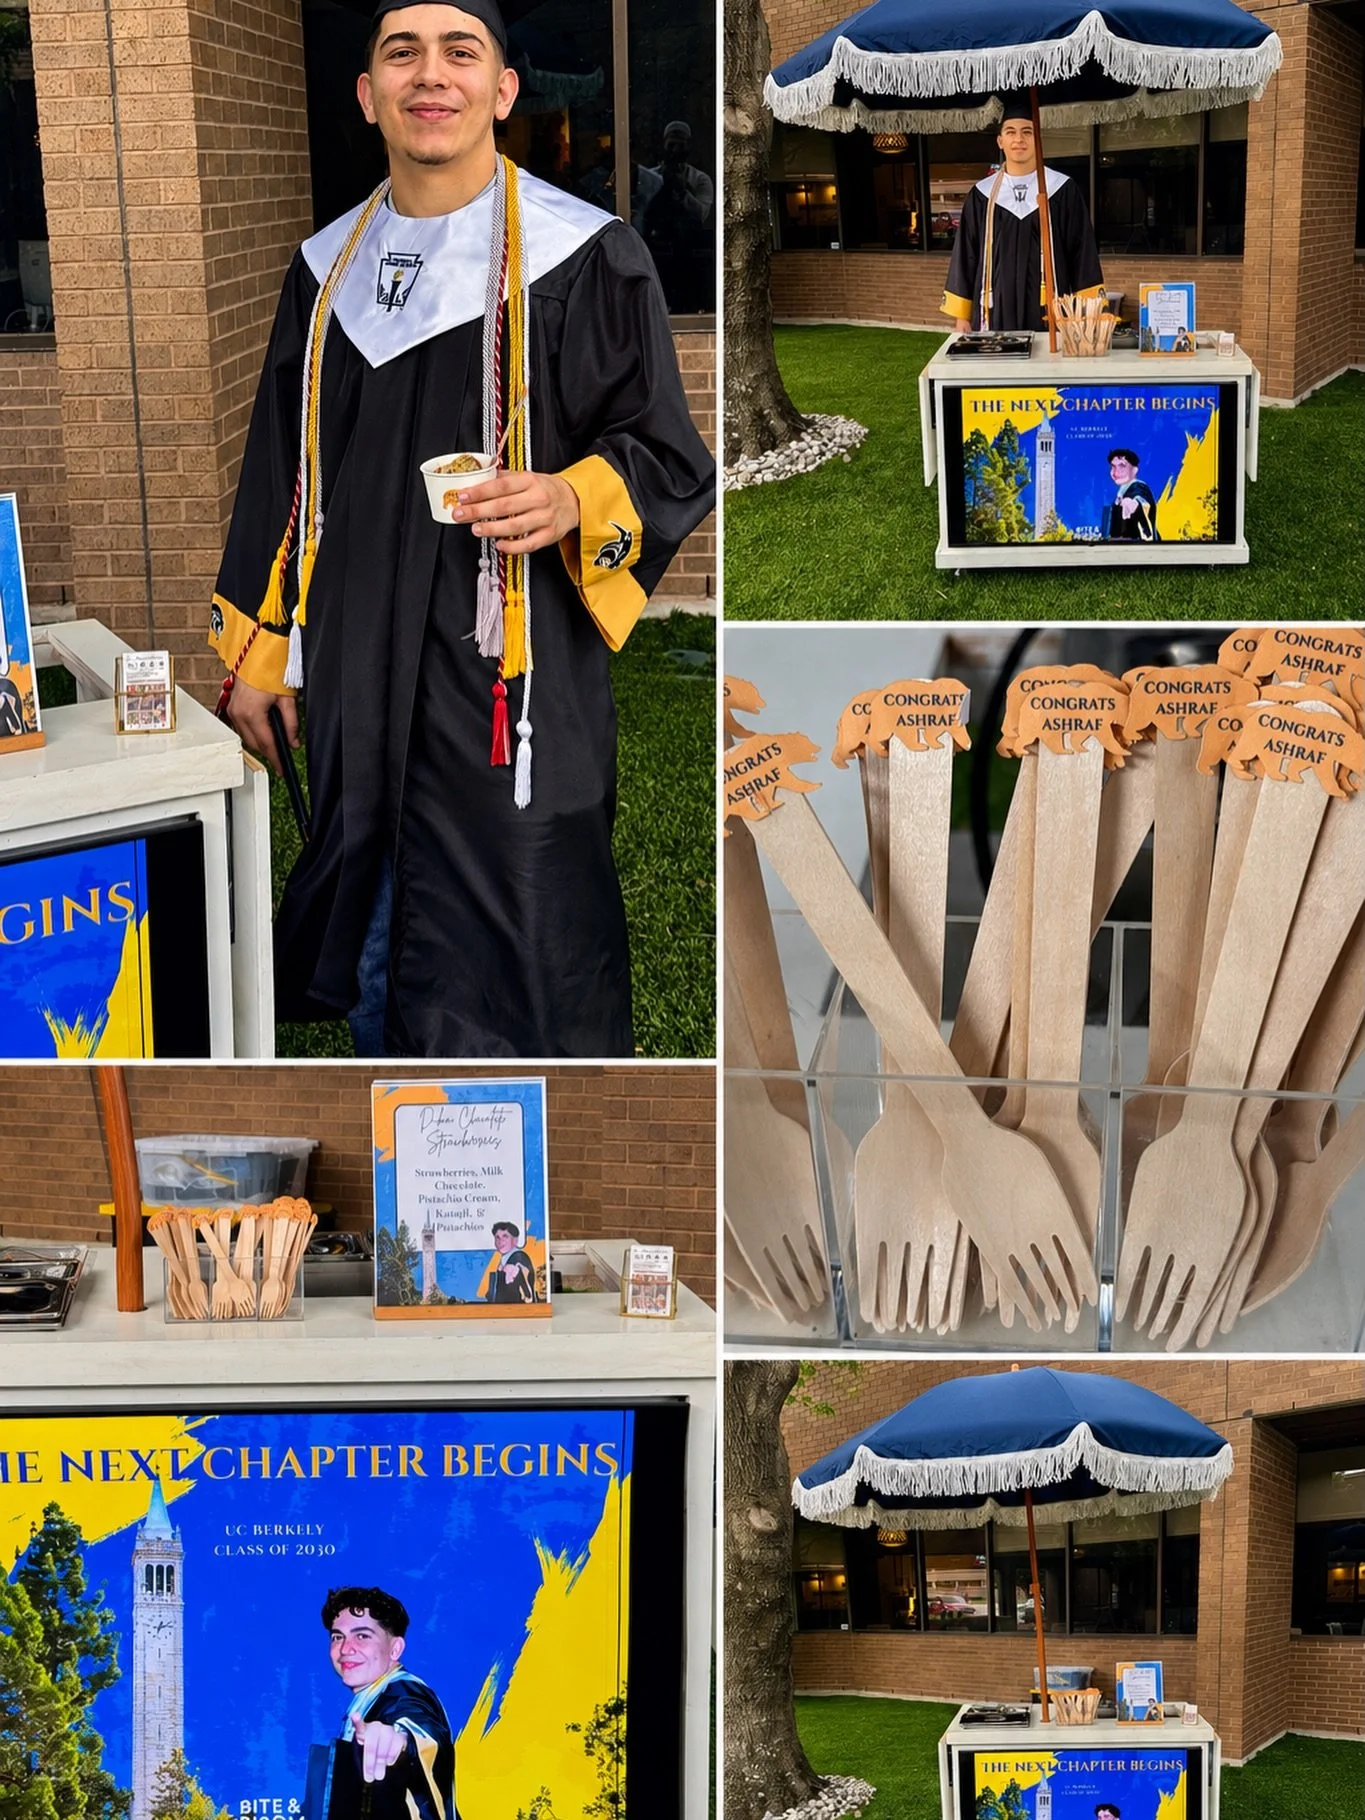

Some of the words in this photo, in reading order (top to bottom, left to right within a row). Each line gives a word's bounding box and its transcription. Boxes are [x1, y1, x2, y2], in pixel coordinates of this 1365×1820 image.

[969, 400, 1006, 413] THE
[1010, 399, 1058, 413] NEXT
[1061, 398, 1146, 412] CHAPTER
[1151, 396, 1216, 411] BEGINS
[1273, 629, 1363, 660] CONGRATS
[1280, 652, 1347, 676] ASHRAF
[1143, 680, 1232, 695] CONGRATS
[1030, 696, 1117, 711] CONGRATS
[1155, 701, 1218, 715] ASHRAF
[896, 713, 957, 727] ASHRAF
[1041, 717, 1104, 731] ASHRAF
[1258, 713, 1347, 747] CONGRATS
[1263, 738, 1328, 765] ASHRAF
[723, 742, 782, 784] NGRATS
[726, 767, 781, 806] ASHRAF
[0, 881, 136, 945] GINS
[480, 1165, 504, 1177] Milk
[418, 1193, 463, 1204] Pistachio
[60, 1448, 189, 1483] NEXT
[202, 1444, 429, 1480] CHAPTER
[442, 1442, 618, 1478] BEGINS
[224, 1524, 248, 1537] UC
[253, 1523, 325, 1536] BERKELY
[213, 1543, 265, 1556] CLASS
[269, 1543, 290, 1556] OF
[295, 1543, 336, 1557] 2030
[981, 1761, 1011, 1773] THE
[1014, 1760, 1056, 1773] NEXT
[1057, 1760, 1127, 1772] CHAPTER
[1131, 1759, 1184, 1771] BEGINS
[240, 1798, 283, 1815] BITE
[287, 1797, 301, 1814] &
